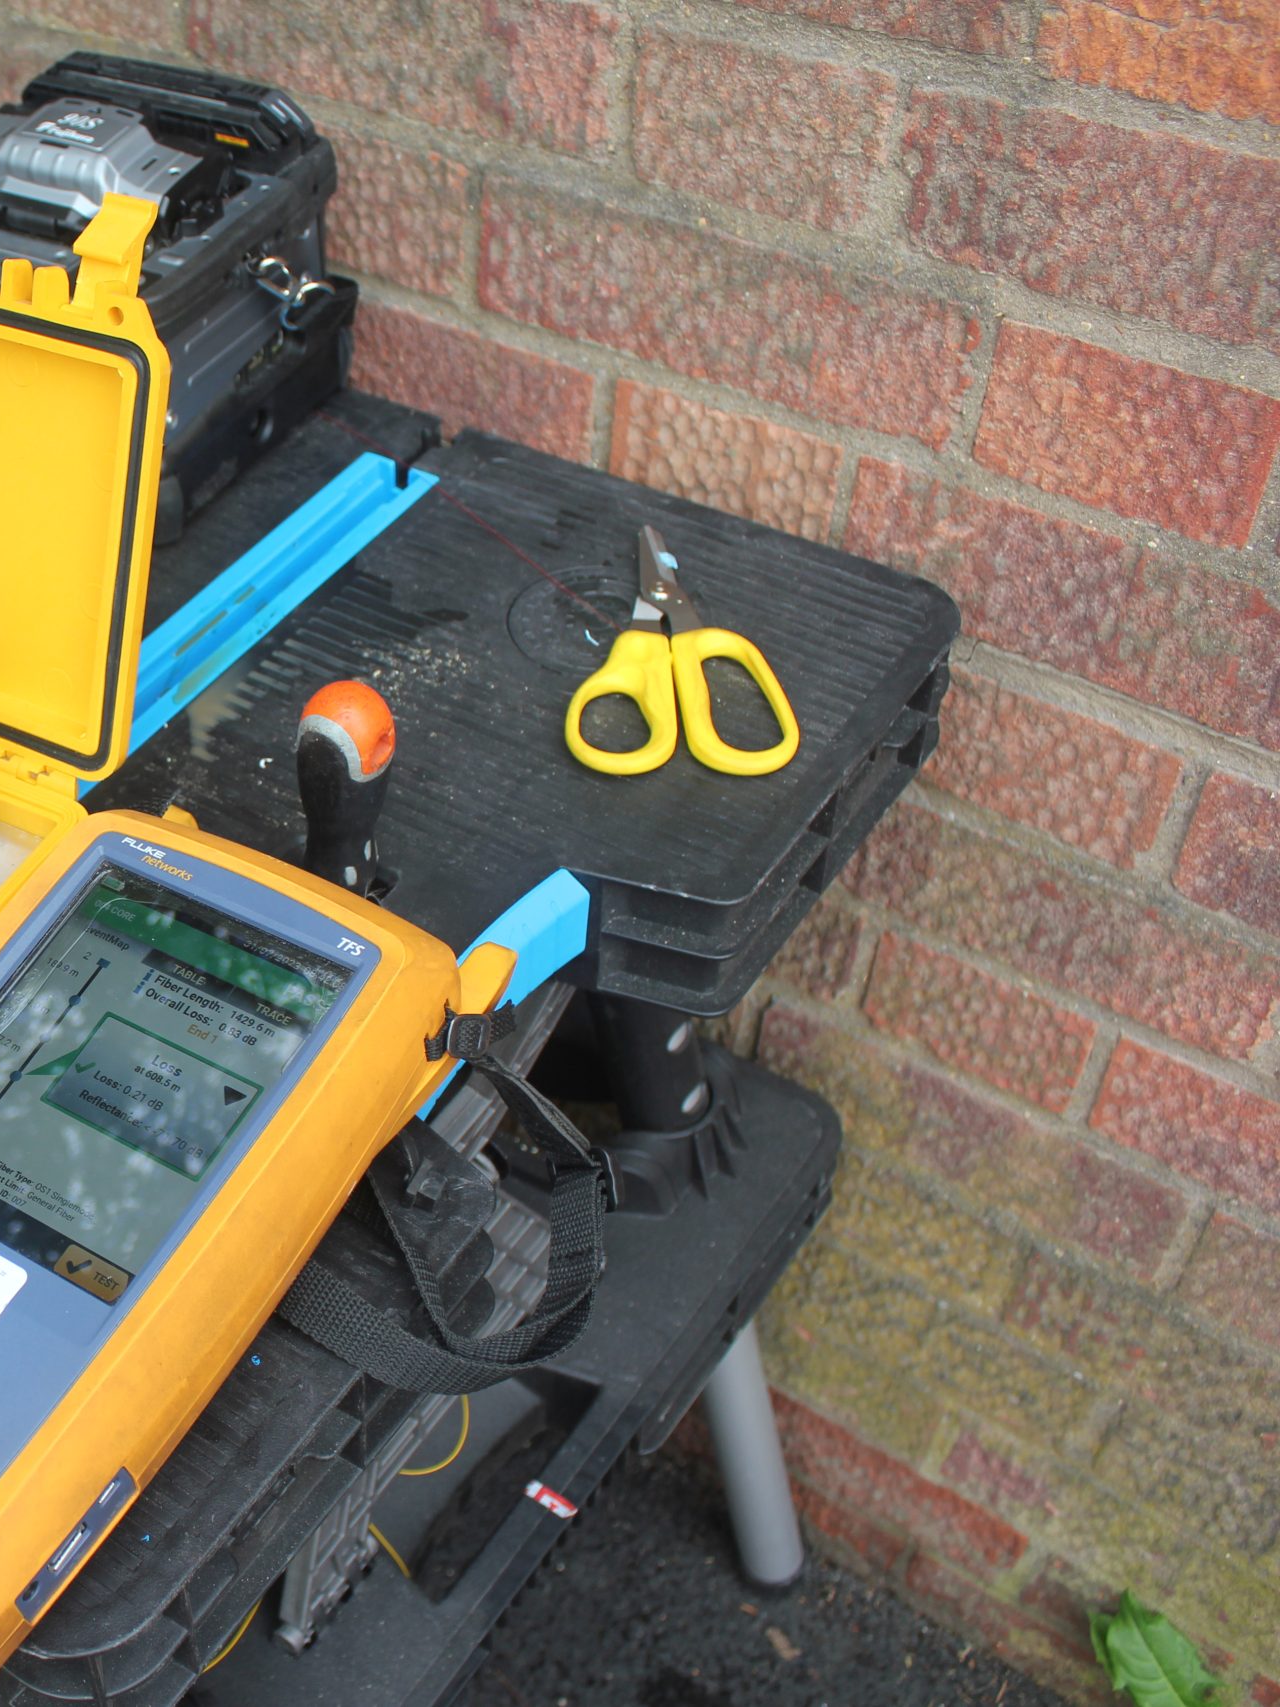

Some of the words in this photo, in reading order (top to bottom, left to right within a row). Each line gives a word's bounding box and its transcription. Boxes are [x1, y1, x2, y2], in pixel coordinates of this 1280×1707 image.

[121, 836, 166, 860] FLUKE
[140, 854, 194, 882] networks
[111, 906, 137, 922] CORE
[82, 951, 92, 961] 2
[336, 936, 366, 957] TFS
[153, 974, 182, 994] Fiber
[182, 986, 224, 1014] Length:
[230, 1009, 263, 1032] 1429.6
[172, 965, 208, 987] TABLE
[255, 1002, 294, 1026] TRACE
[145, 987, 182, 1013] Overall
[183, 1004, 213, 1027] Loss:
[241, 1032, 258, 1047] dB
[186, 1023, 209, 1042] End
[133, 1064, 145, 1076] at
[145, 1068, 172, 1088] 608.5
[151, 1054, 183, 1078] Loss
[93, 1069, 122, 1092] Loss:
[122, 1084, 146, 1104] 0.21
[146, 1098, 164, 1112] dB
[14, 1169, 34, 1187] Type:
[34, 1182, 52, 1197] OS1
[0, 1187, 12, 1199] ID:
[11, 1195, 28, 1208] 007
[27, 1190, 57, 1212] General
[56, 1206, 75, 1222] Fiber
[92, 1271, 121, 1292] TEST
